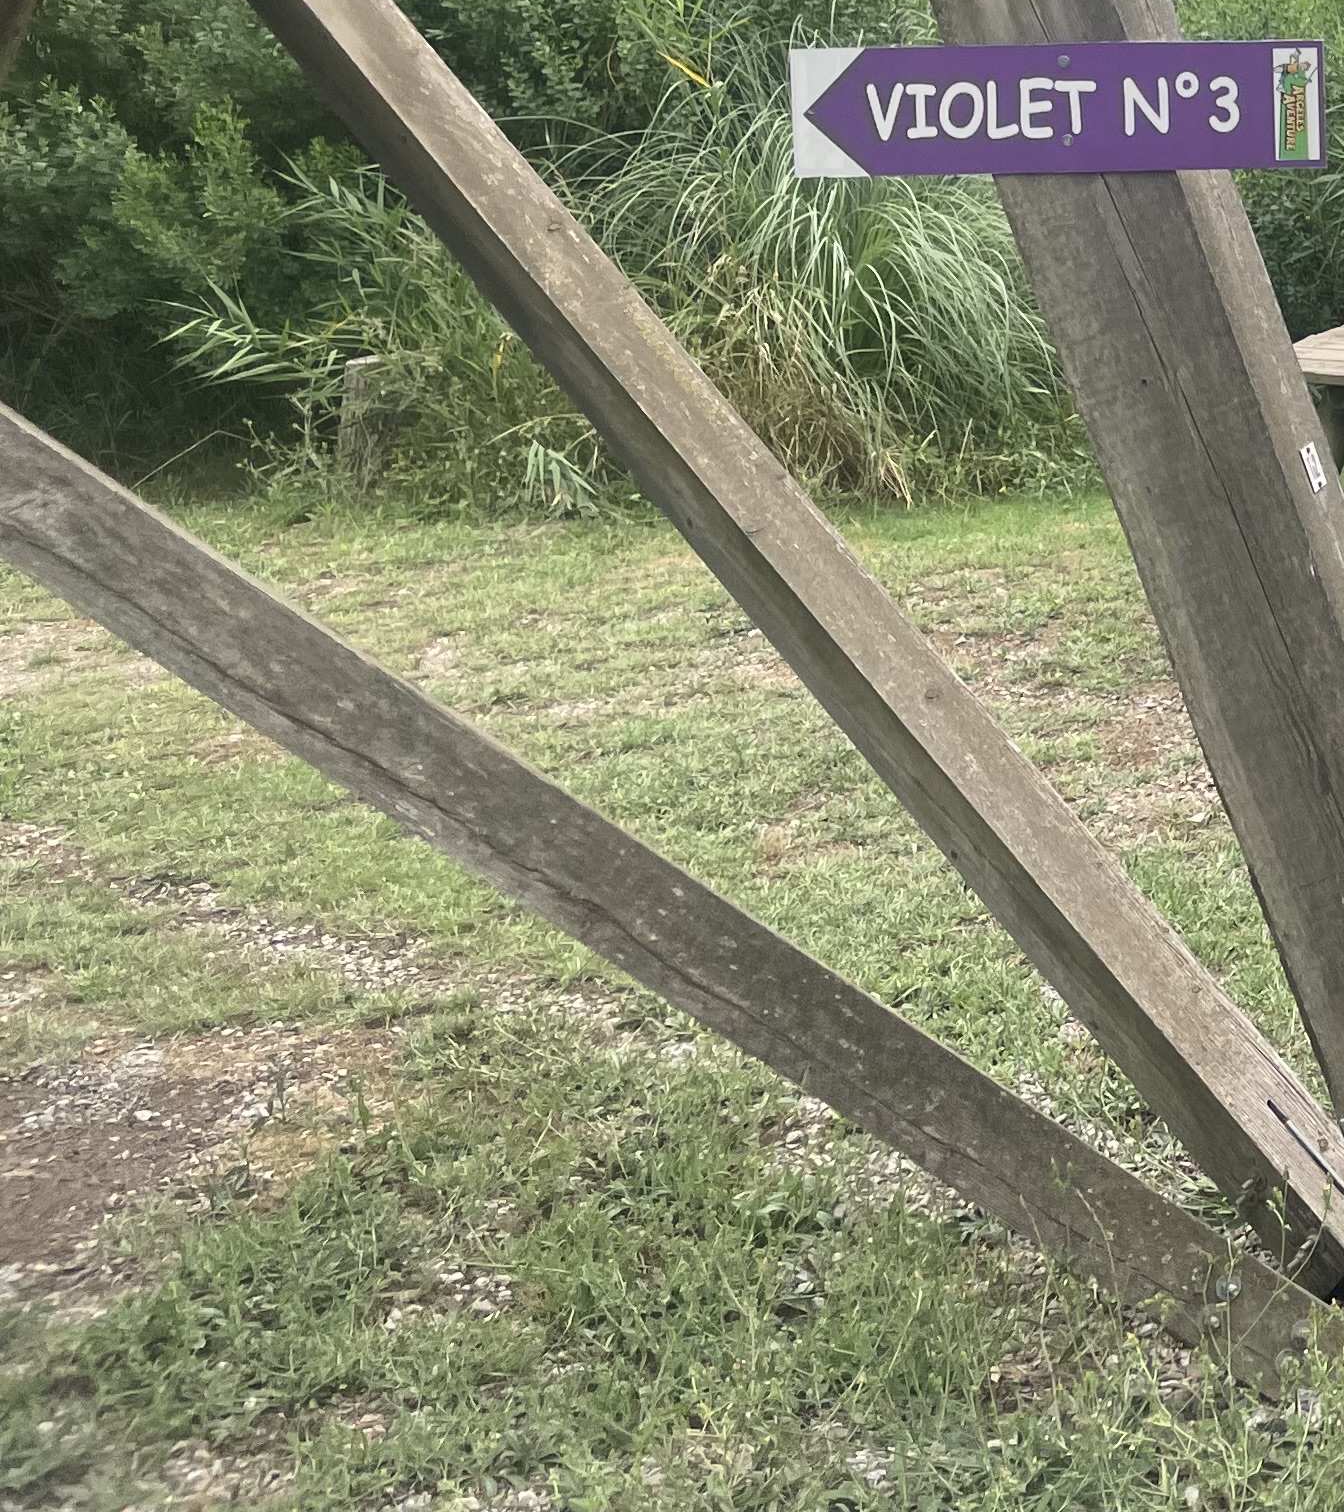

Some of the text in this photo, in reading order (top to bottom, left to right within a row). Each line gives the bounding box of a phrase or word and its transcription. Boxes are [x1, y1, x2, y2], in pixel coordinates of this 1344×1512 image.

[865, 70, 1241, 142] VIOLET N°3
[1283, 95, 1296, 151] AVENTURE
